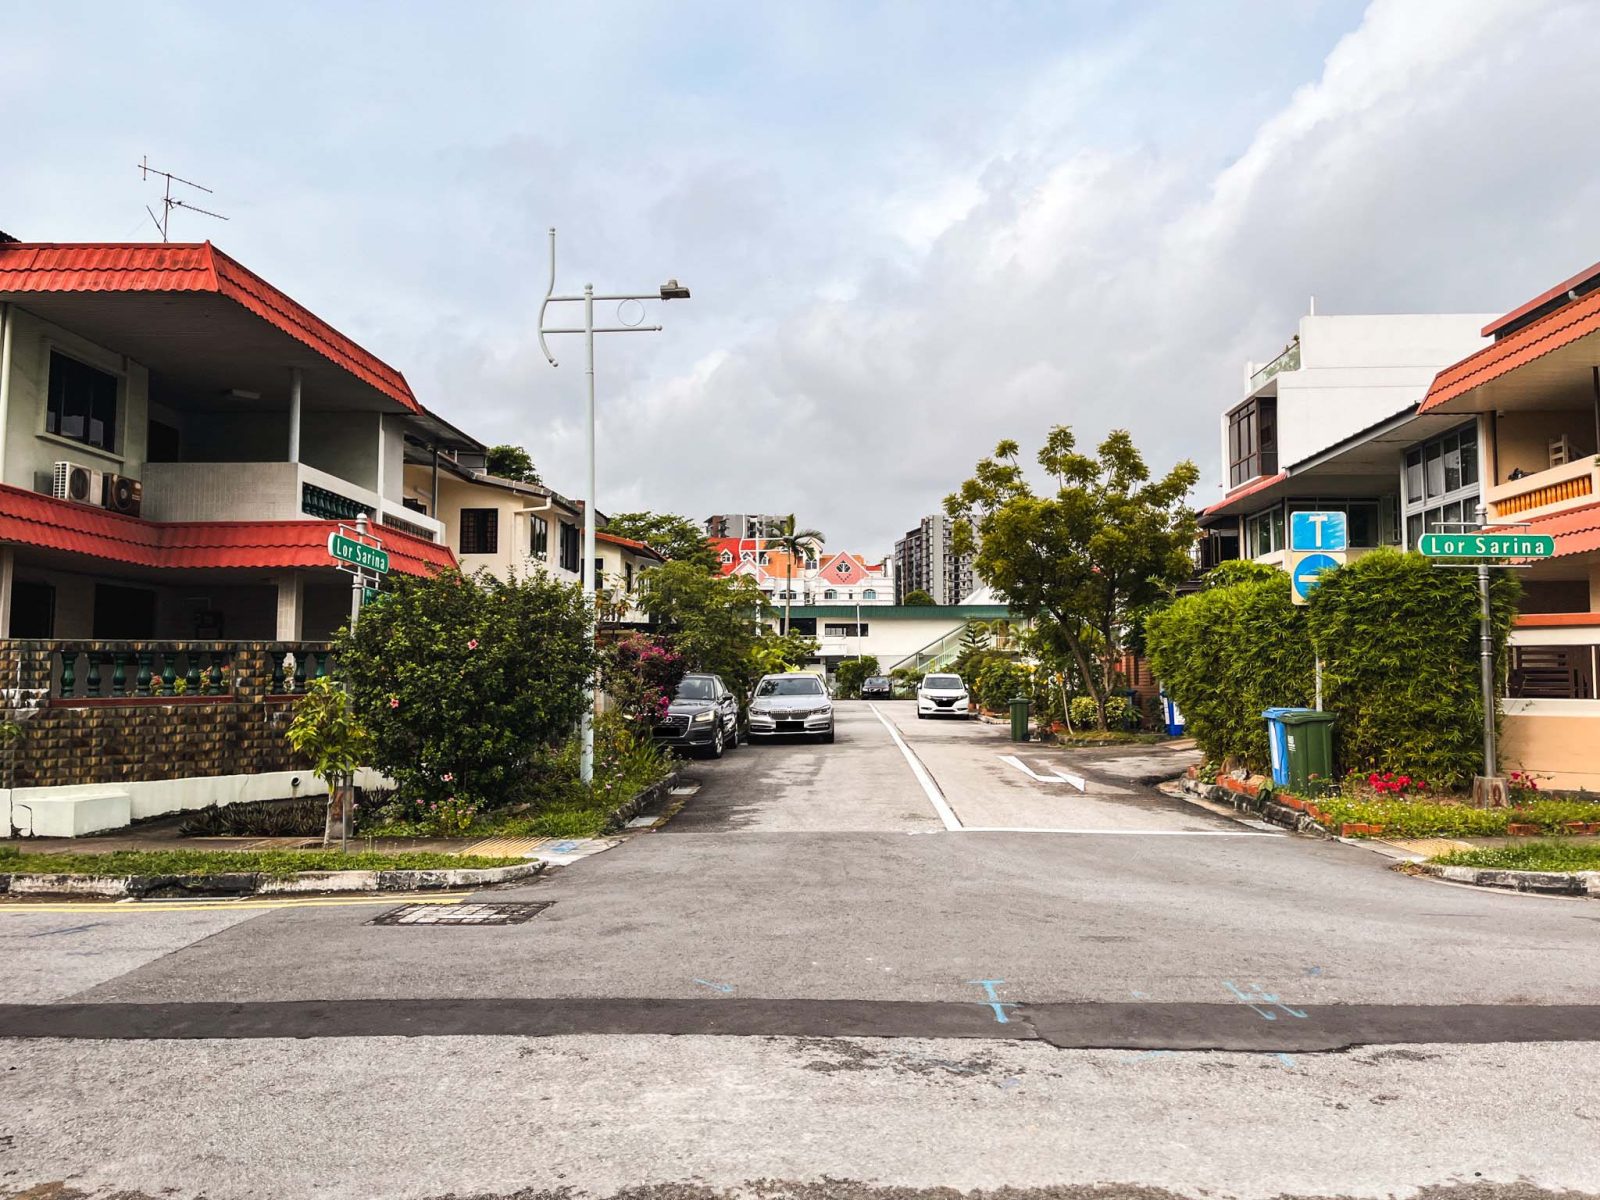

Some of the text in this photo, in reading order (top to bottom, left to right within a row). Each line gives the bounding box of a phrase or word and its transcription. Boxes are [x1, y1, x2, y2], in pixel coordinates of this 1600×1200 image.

[337, 538, 385, 570] Lor Sarina
[1431, 537, 1544, 554] Lor Sarina
